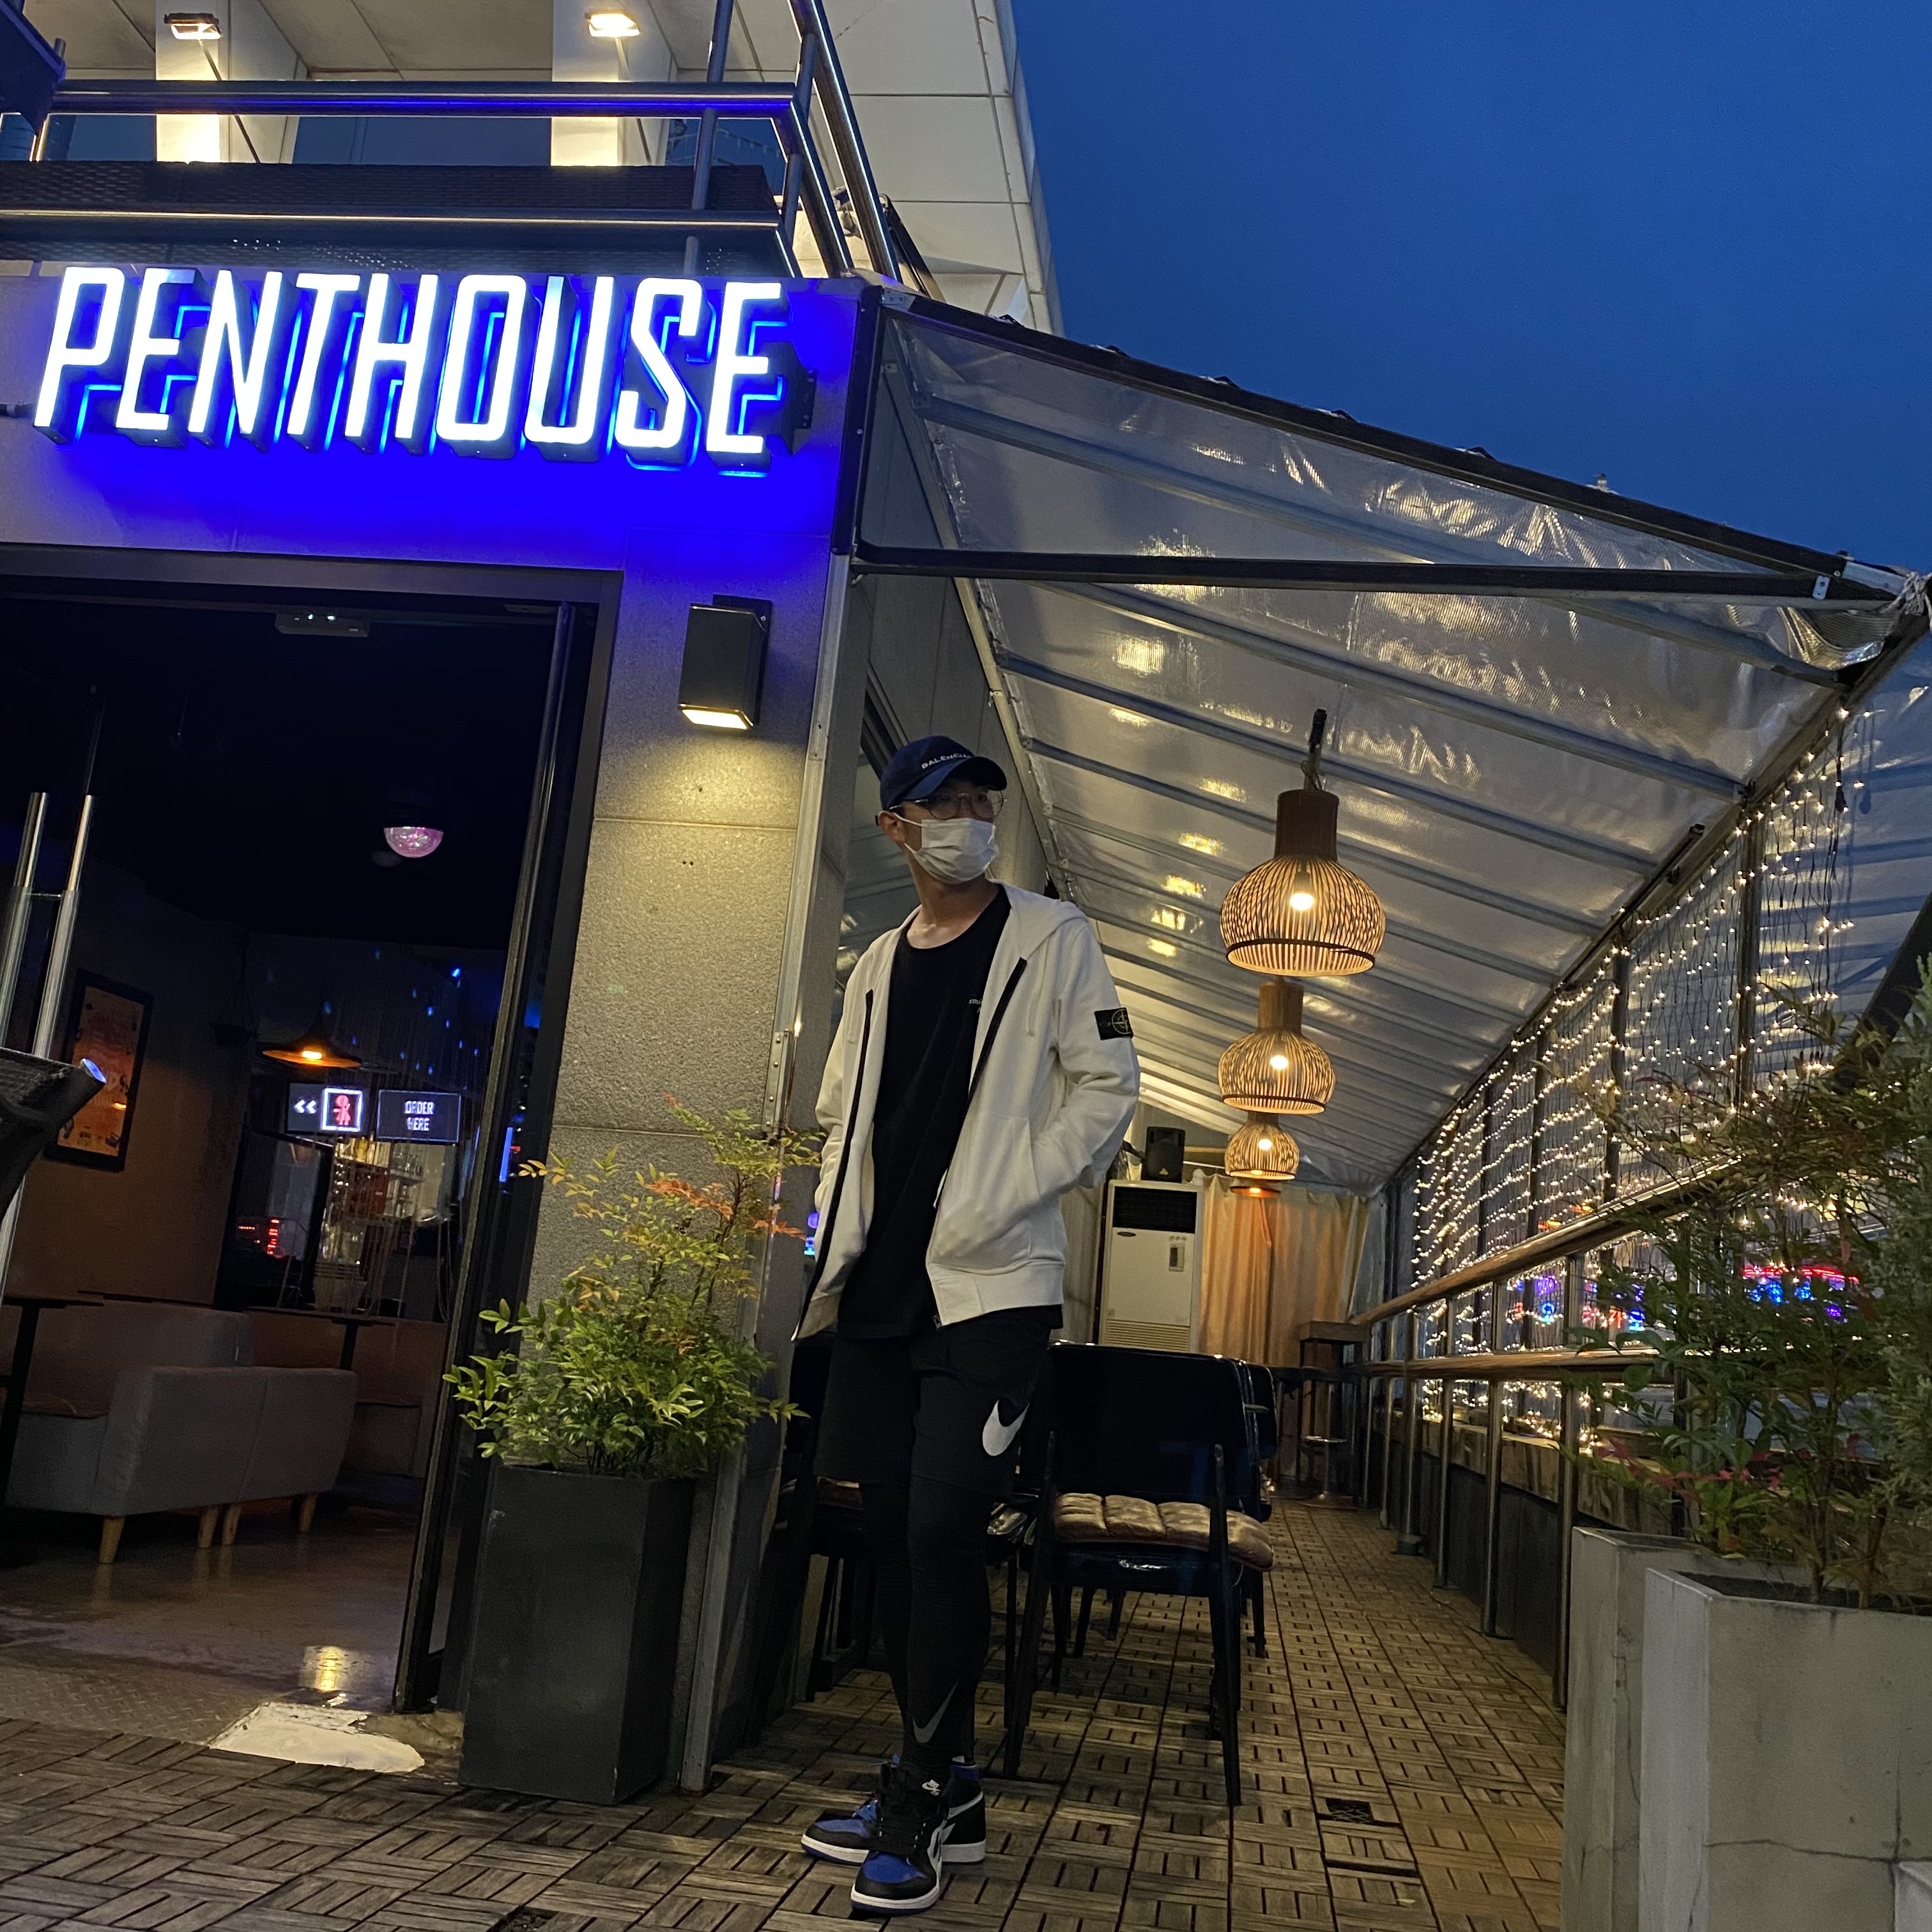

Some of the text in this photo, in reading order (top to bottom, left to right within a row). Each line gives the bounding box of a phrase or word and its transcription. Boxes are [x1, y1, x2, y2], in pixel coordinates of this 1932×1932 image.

[34, 266, 782, 457] PENTHOUSE
[404, 1100, 434, 1114] ORDER
[406, 1117, 429, 1131] HERE
